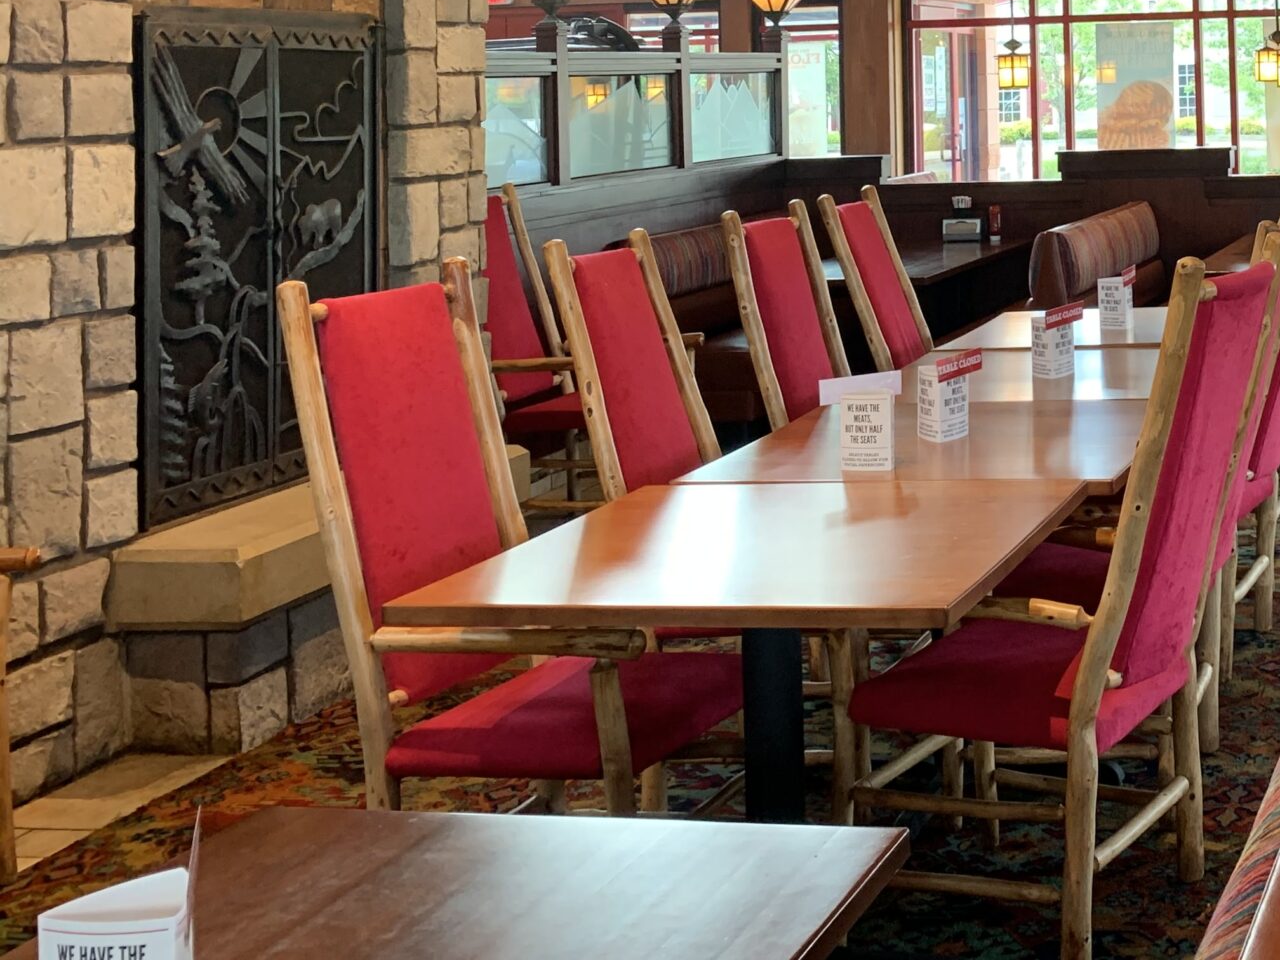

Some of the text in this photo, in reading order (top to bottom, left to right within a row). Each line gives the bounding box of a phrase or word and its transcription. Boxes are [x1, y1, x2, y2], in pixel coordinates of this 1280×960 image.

[847, 403, 880, 413] WE HAVE THE
[845, 424, 883, 433] BUT ONLY HALF
[850, 435, 877, 444] THE SEATS
[57, 943, 147, 960] WE HAVE THE
